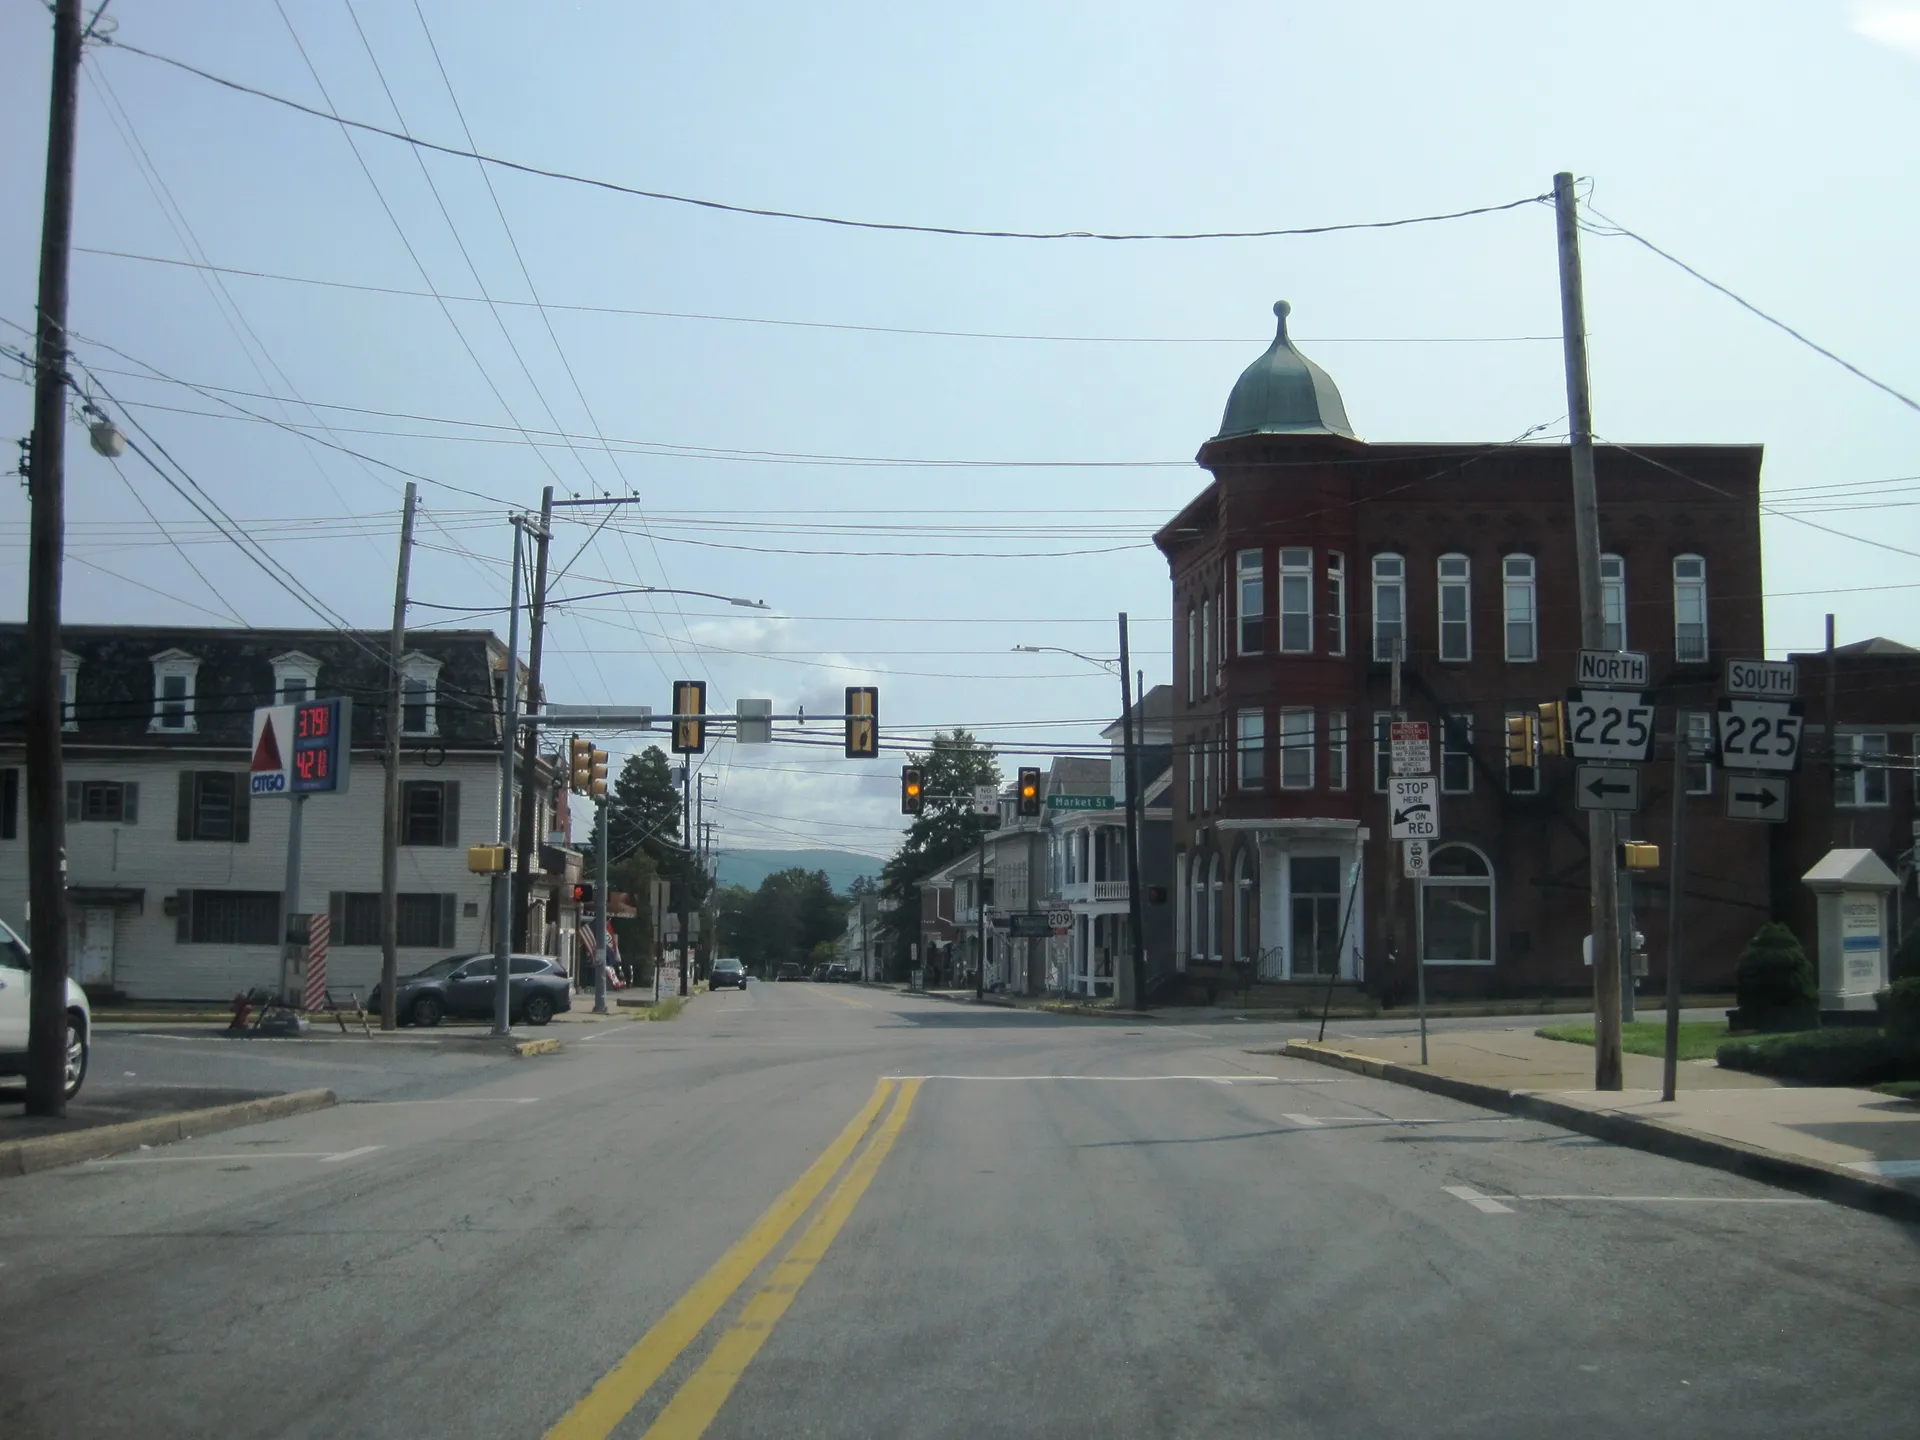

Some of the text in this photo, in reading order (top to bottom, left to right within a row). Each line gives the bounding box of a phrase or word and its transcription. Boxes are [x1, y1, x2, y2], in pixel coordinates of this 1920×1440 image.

[1583, 656, 1643, 680] NORTH
[1732, 666, 1792, 690] SOUTH
[1574, 706, 1649, 747] 225
[1724, 716, 1798, 757] 225
[252, 774, 286, 792] CITGO
[1396, 783, 1429, 794] STOP
[1055, 796, 1107, 807] Market St
[1403, 796, 1423, 804] HERE
[1408, 823, 1434, 834] RED
[1049, 913, 1070, 925] 209
